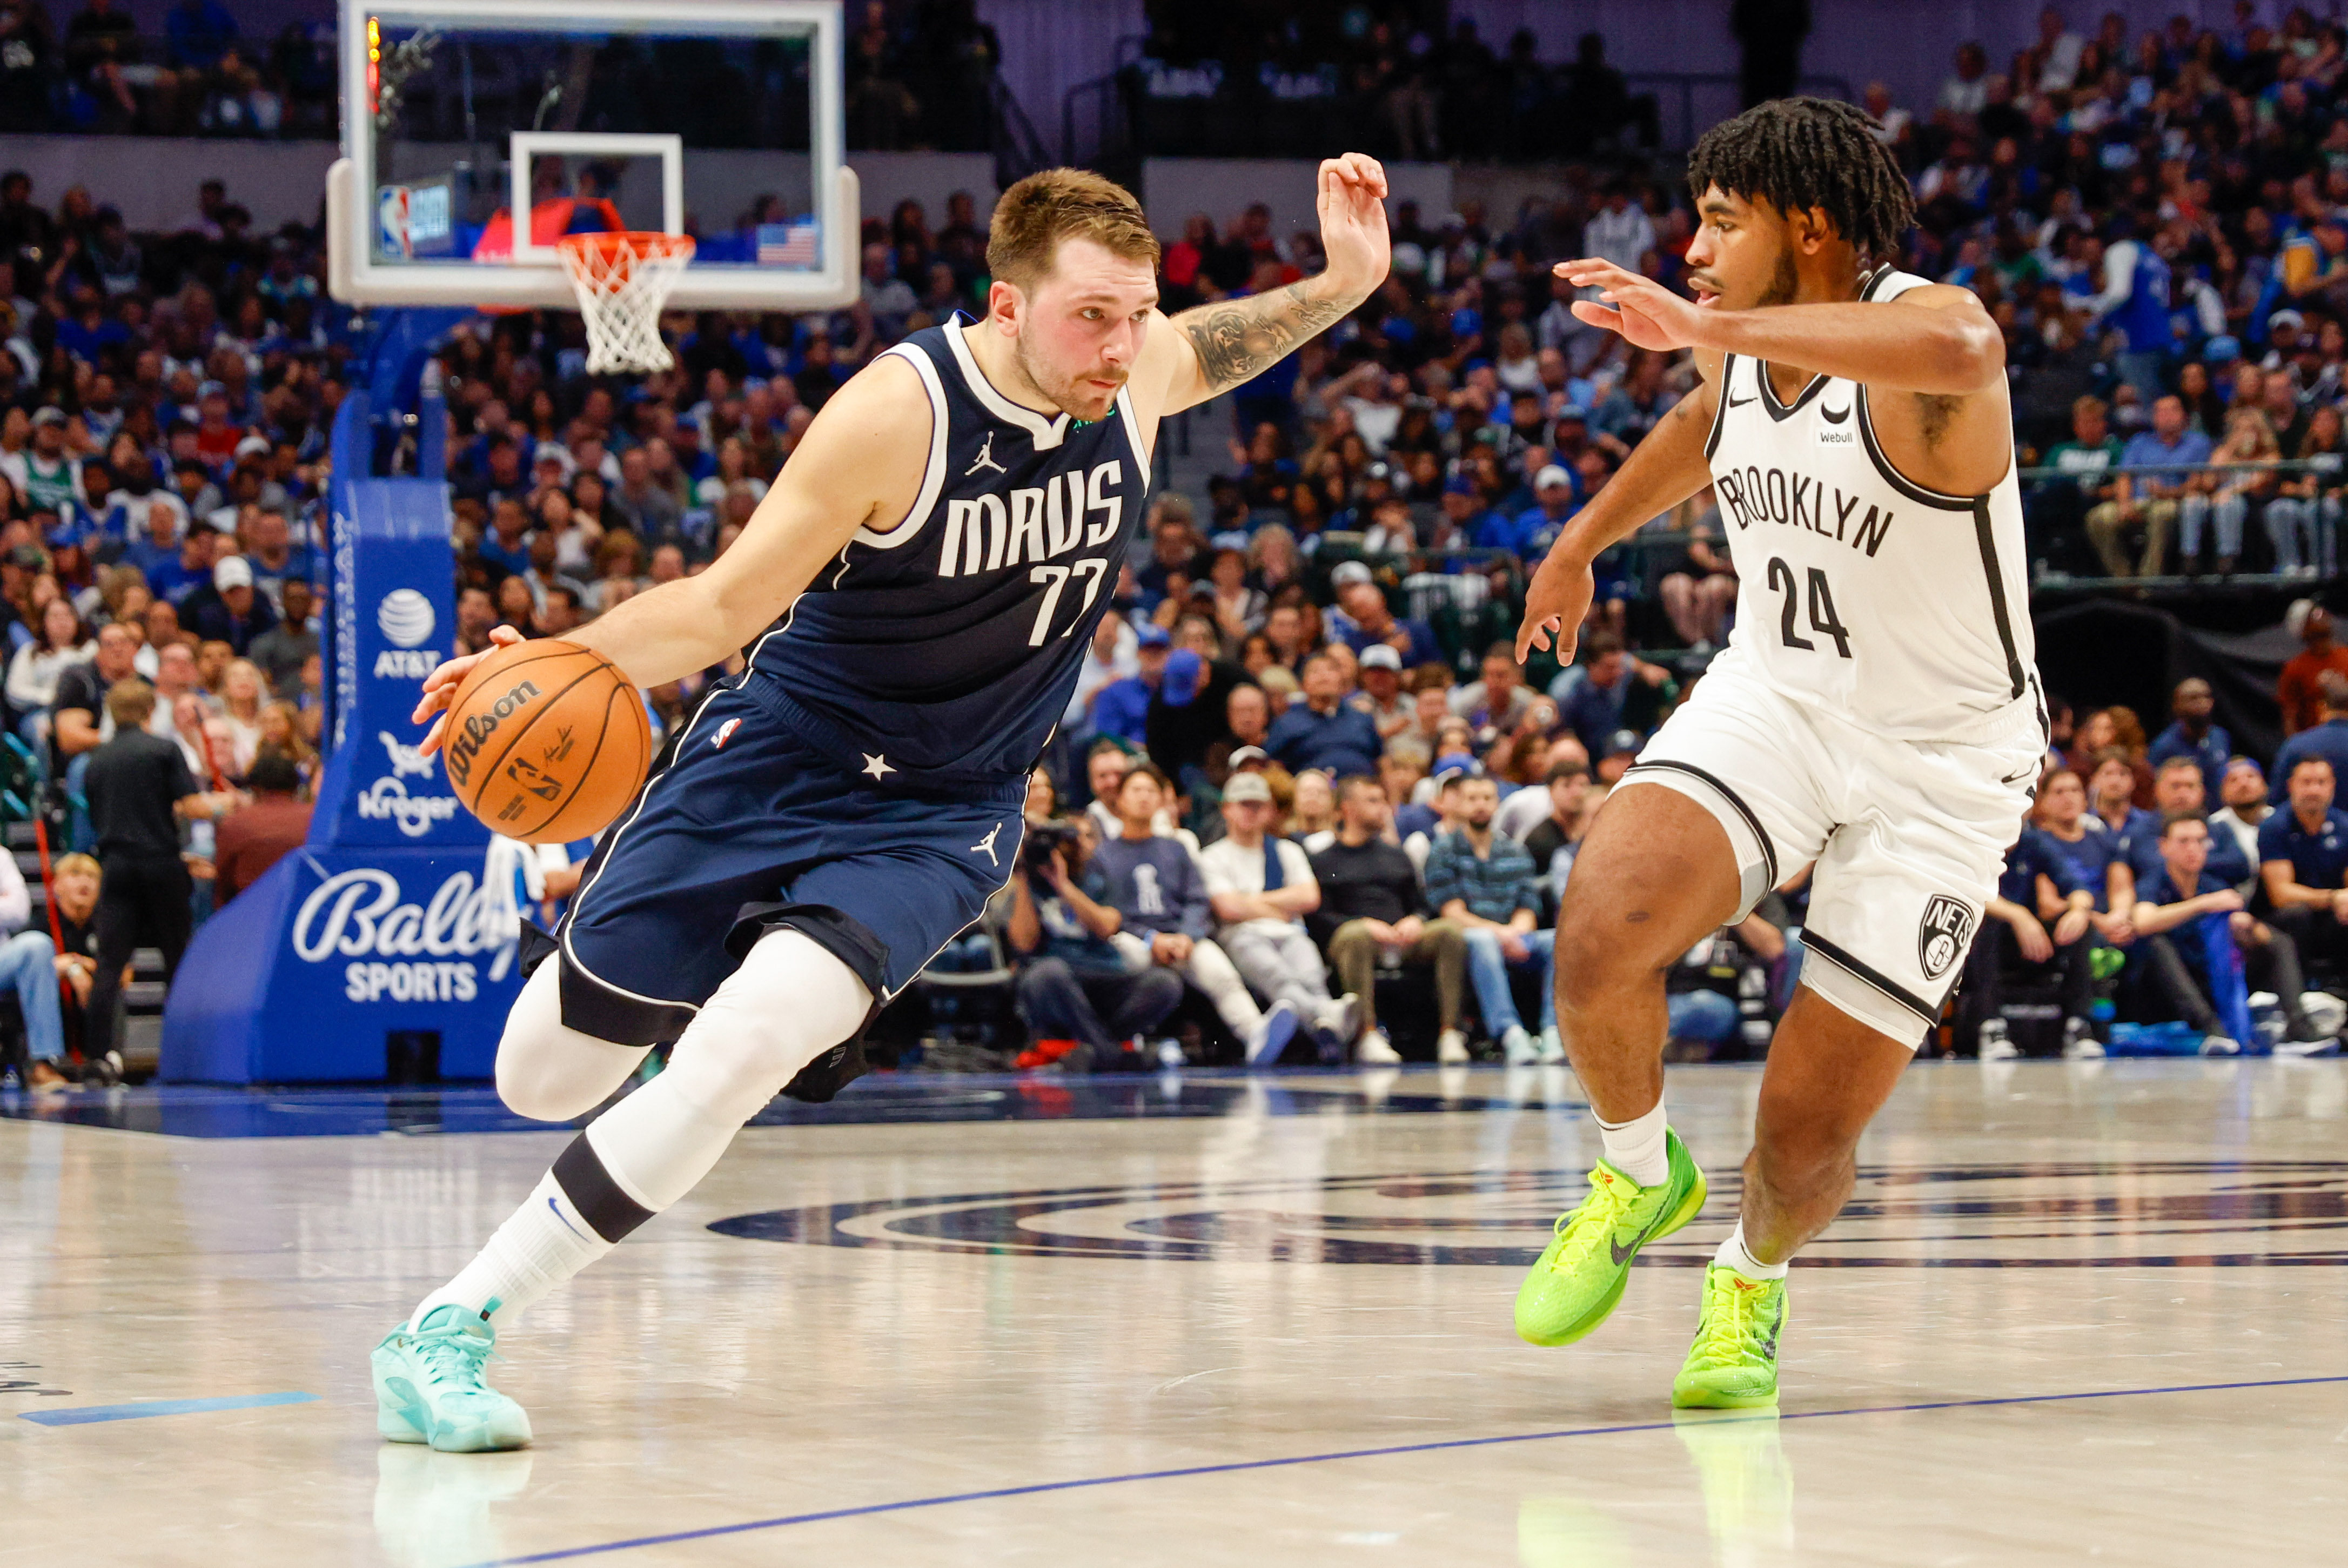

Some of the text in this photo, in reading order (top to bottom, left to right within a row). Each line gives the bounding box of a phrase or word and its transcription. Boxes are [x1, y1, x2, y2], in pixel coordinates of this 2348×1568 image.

[1820, 432, 1853, 443] Webull
[938, 460, 1122, 577] MAVS
[1717, 465, 1894, 558] BROOKLYN
[1028, 558, 1108, 646] 77
[1768, 557, 1852, 658] 24
[373, 650, 442, 678] AT&T
[448, 679, 542, 787] Wilson
[358, 776, 459, 837] Kroger
[1926, 900, 1973, 947] NETS
[345, 962, 478, 1003] SPORTS
